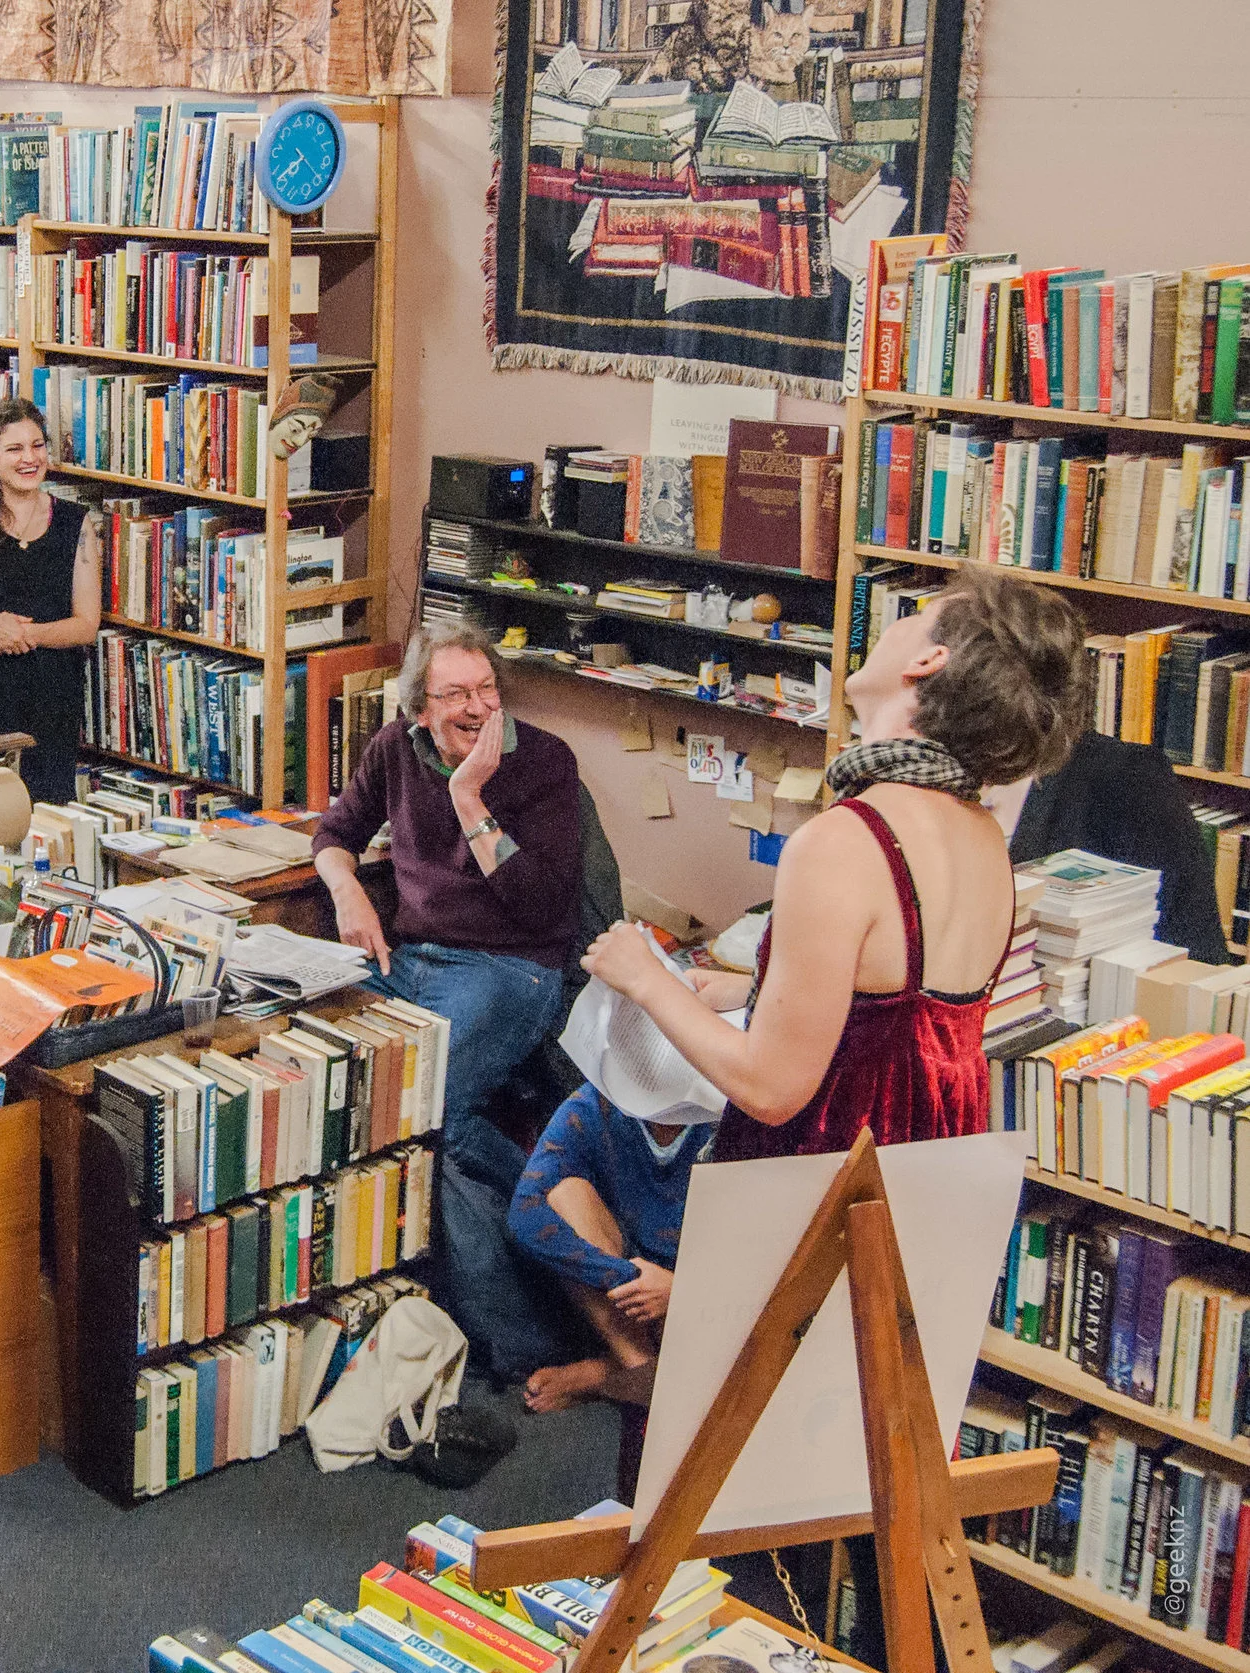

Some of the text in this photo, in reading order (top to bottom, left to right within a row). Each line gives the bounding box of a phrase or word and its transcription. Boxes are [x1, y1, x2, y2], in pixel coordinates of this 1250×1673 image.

[12, 142, 19, 155] A
[12, 158, 23, 171] OF
[845, 275, 867, 393] CLASSICS
[1027, 325, 1042, 360] EGYPT
[670, 419, 710, 431] LEAVING
[690, 432, 727, 444] RINGED
[678, 440, 704, 452] WITH
[287, 553, 312, 565] lington
[850, 577, 868, 648] BRITANNIA
[208, 685, 218, 735] WEST
[157, 1094, 165, 1194] FIRST LIGHT
[1085, 1270, 1104, 1354] CHARYN
[553, 1596, 599, 1624] BILL
[474, 1624, 509, 1647] GEORGE
[407, 1634, 465, 1673] BRYSON
